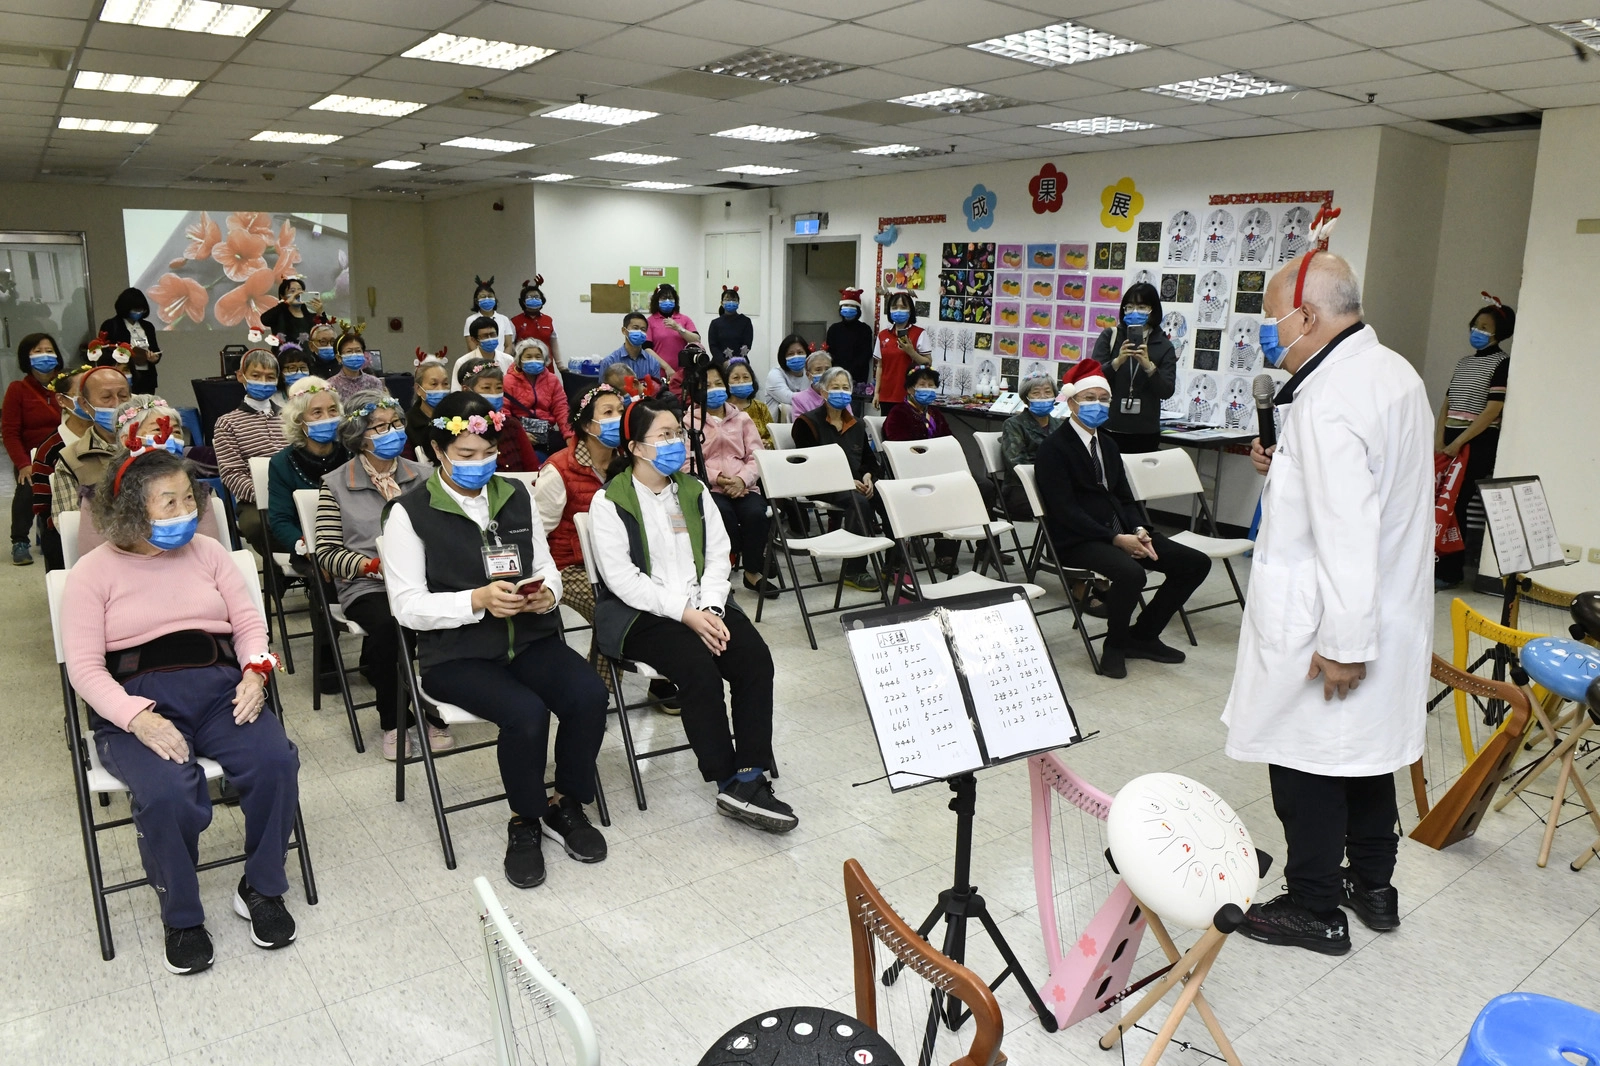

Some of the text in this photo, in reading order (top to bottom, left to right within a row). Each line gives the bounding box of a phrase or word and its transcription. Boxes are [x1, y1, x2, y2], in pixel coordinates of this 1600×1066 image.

[972, 179, 1132, 219] 成 果 展
[1182, 843, 1192, 853] 2
[1218, 872, 1225, 881] 4
[858, 1053, 867, 1064] 7
